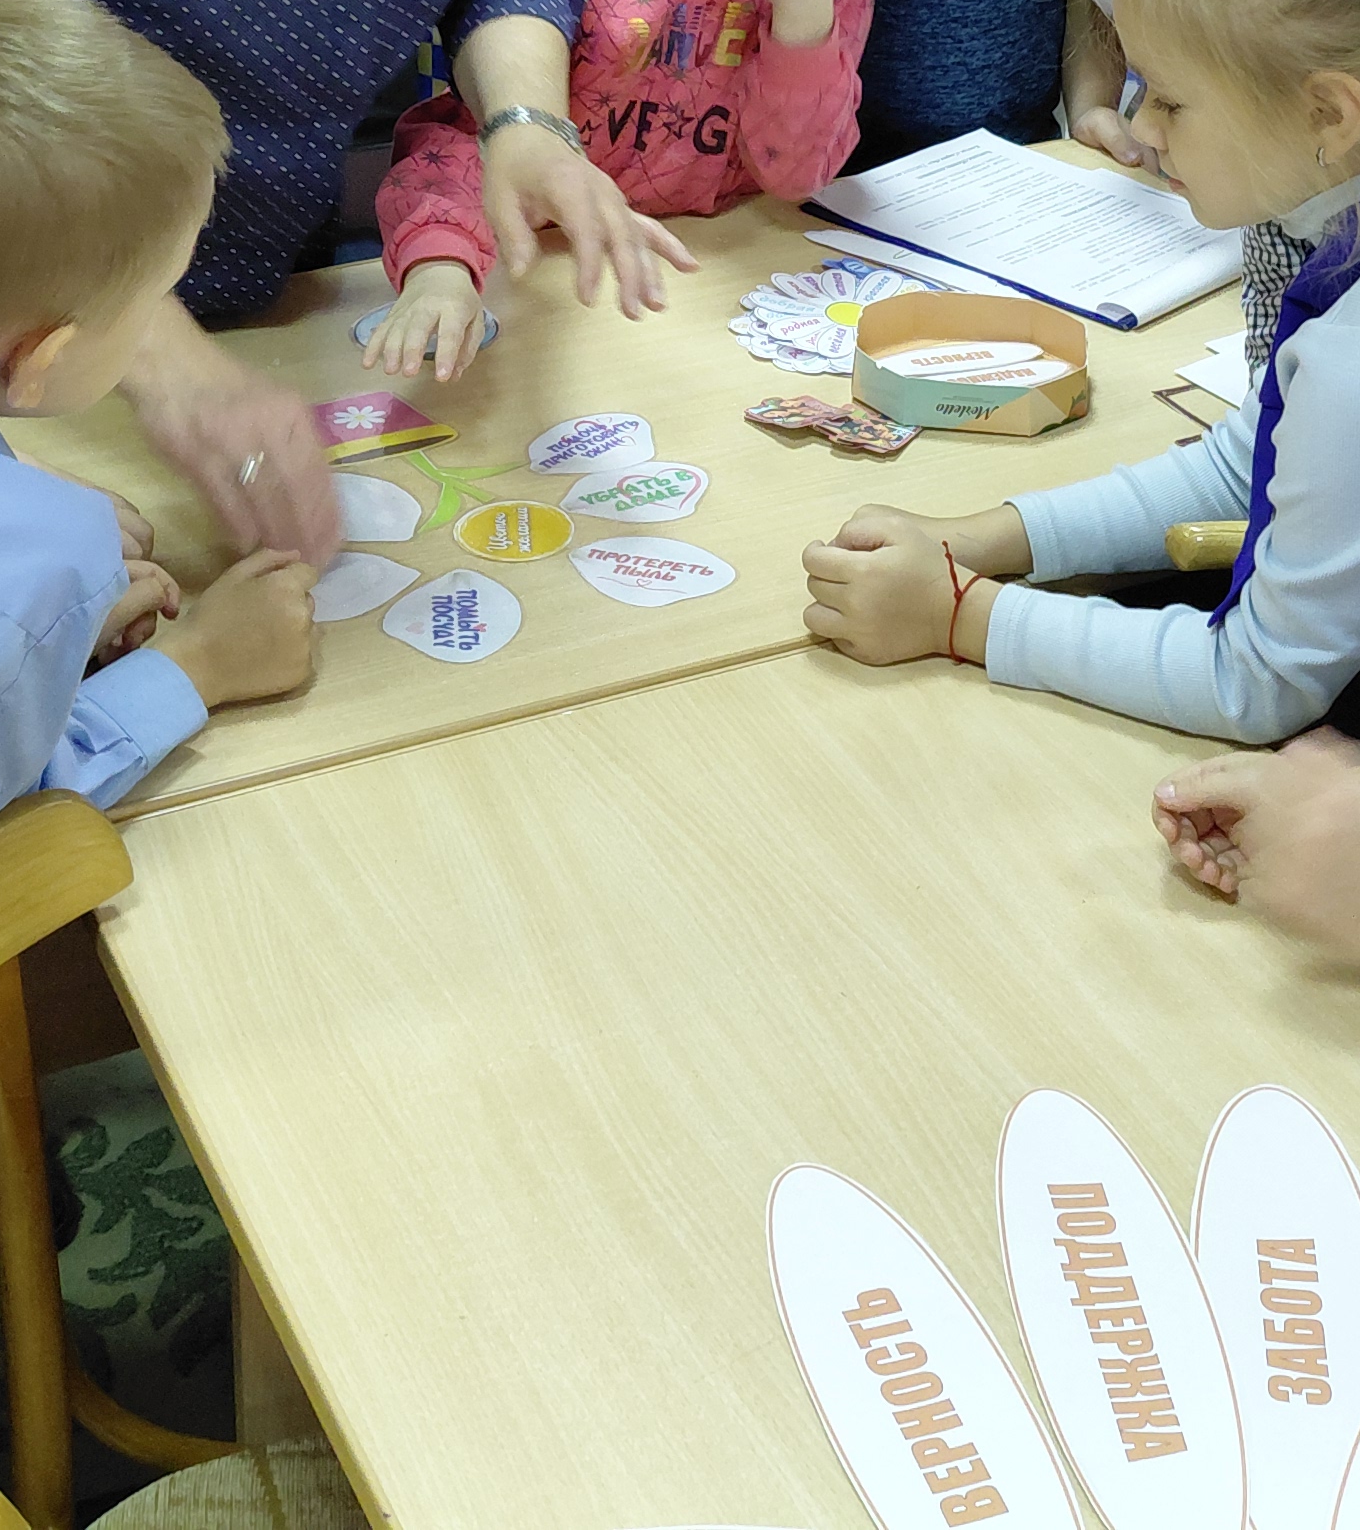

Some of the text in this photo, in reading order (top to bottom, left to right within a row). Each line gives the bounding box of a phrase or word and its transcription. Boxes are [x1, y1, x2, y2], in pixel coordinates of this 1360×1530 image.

[780, 318, 820, 336] родная
[911, 350, 995, 367] ВЕРНОСТЬ
[936, 403, 1000, 421] Merletto
[538, 420, 640, 469] ПРИГОТОВИТЬ
[546, 423, 608, 453] ПОМОЧЬ
[581, 435, 626, 459] УЖИН
[578, 470, 694, 505] УБРАТЬ В
[614, 485, 686, 511] ДОМЕ
[587, 548, 714, 577] ПРОТЕРЕТЬ
[612, 564, 677, 582] ПЫЛЬ
[431, 595, 455, 648] ПОСУДУ
[455, 589, 481, 650] ПОМЫТЬ
[1047, 1182, 1188, 1462] ПОДДЕРЖКА
[1256, 1238, 1332, 1406] ЗАБОТА
[842, 1287, 1009, 1527] ВЕРНОСТЬ
